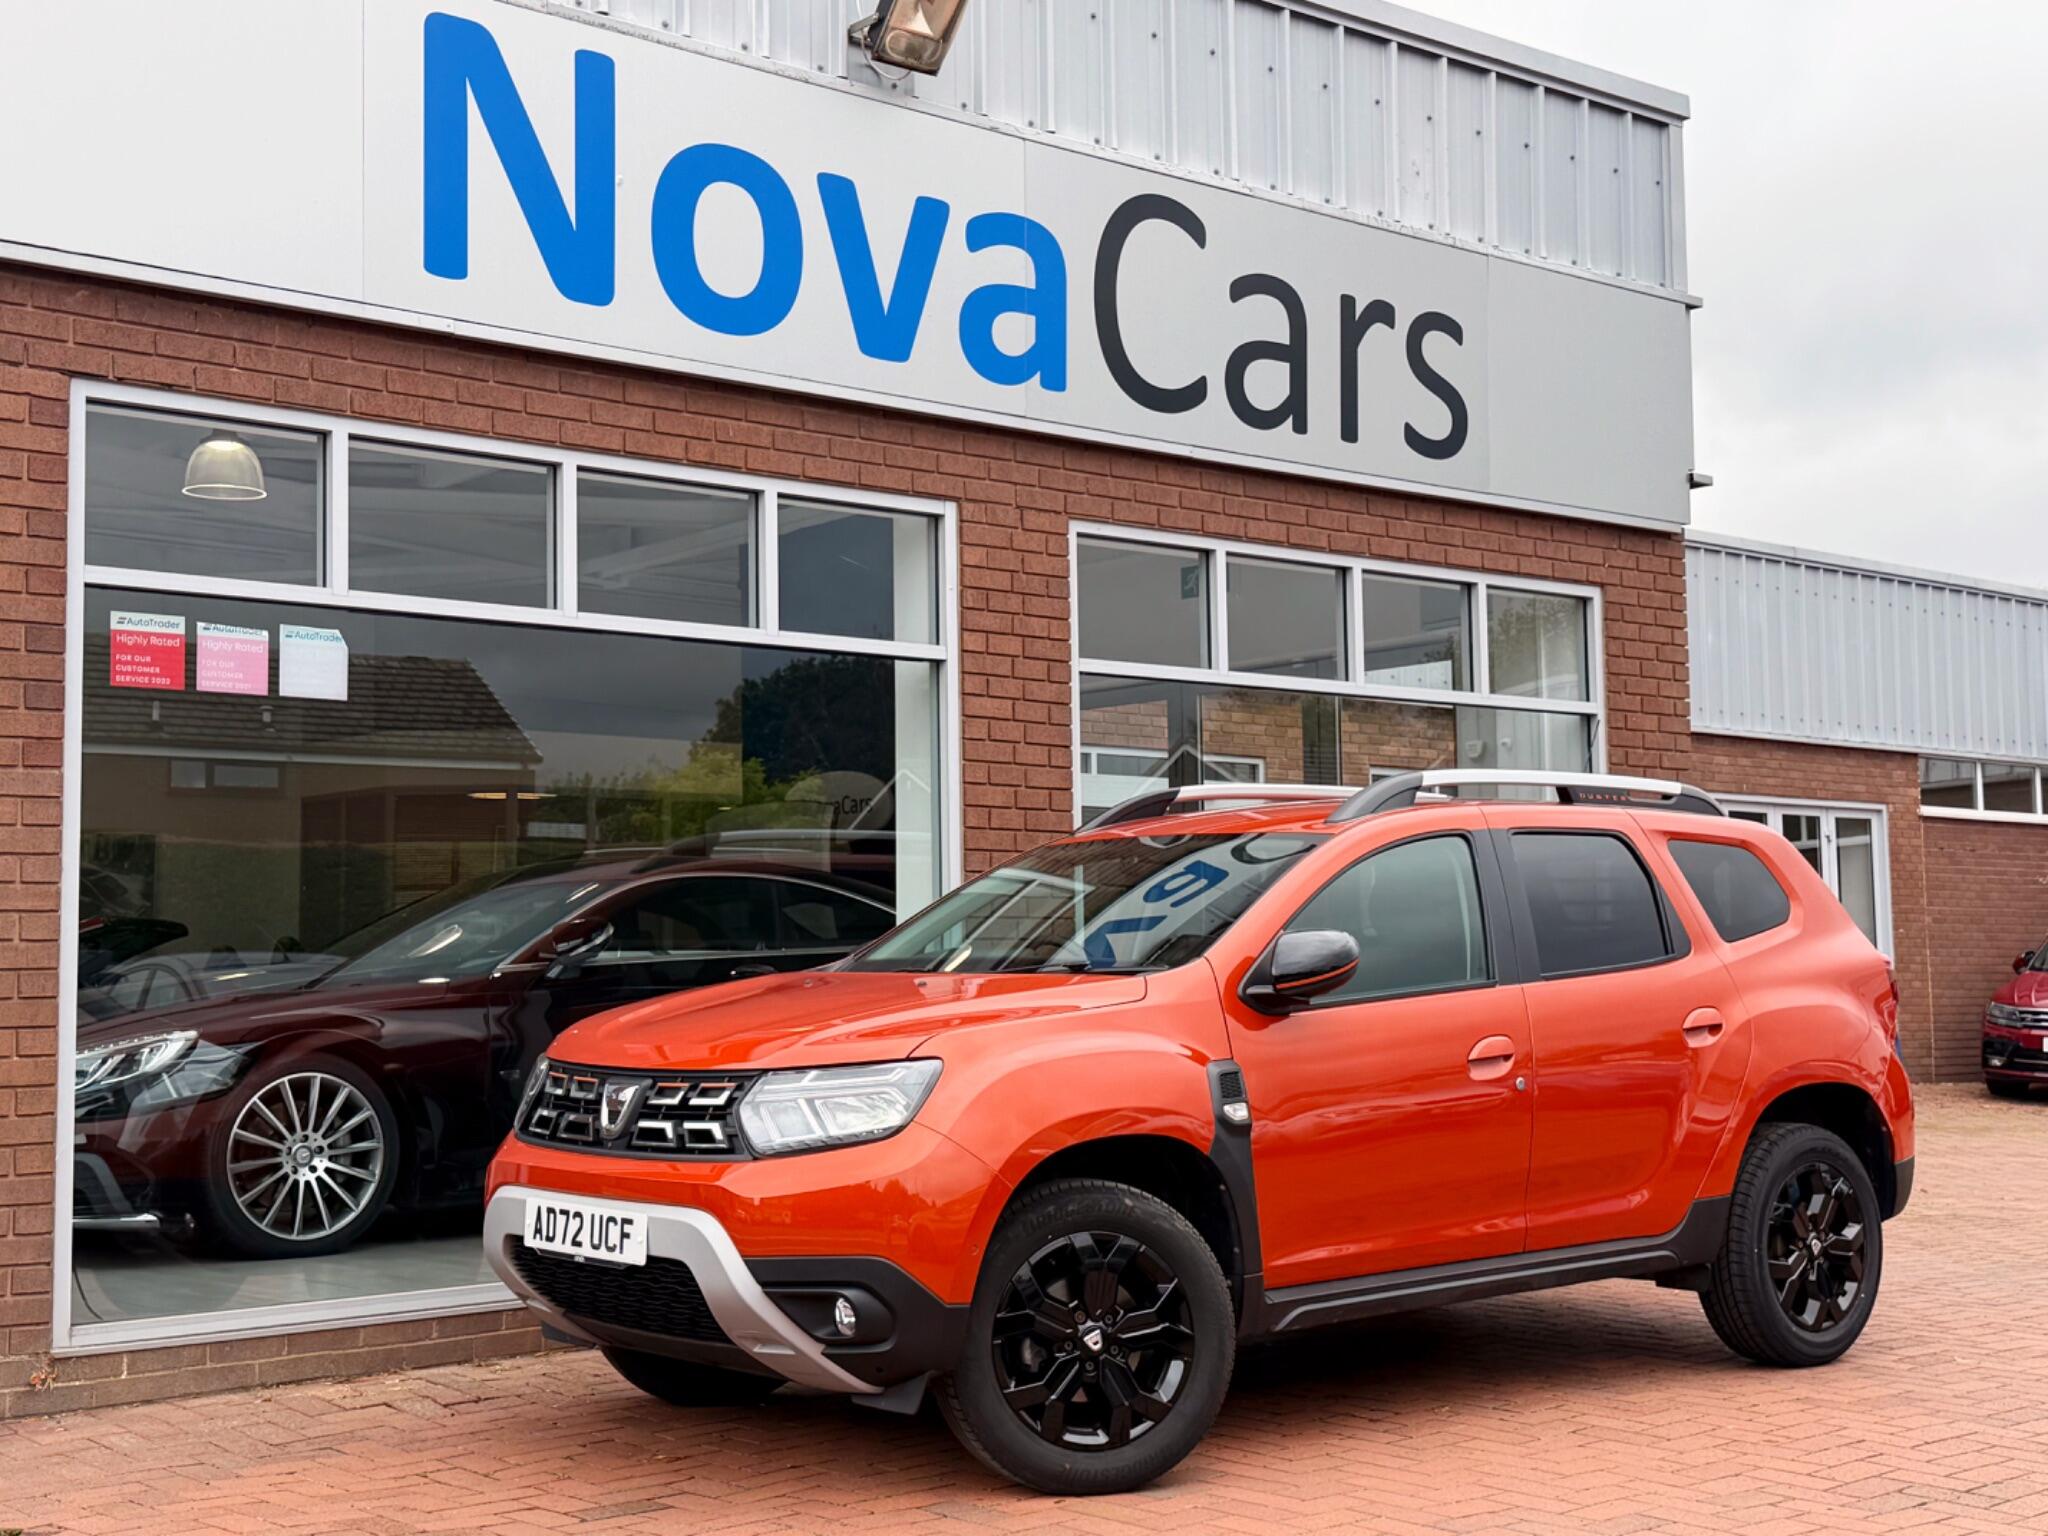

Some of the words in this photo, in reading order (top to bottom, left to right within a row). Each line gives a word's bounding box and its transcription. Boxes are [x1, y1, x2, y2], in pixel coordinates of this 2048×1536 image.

[424, 13, 1468, 461] NovaCars
[126, 617, 181, 630] AutoTrader
[115, 633, 148, 647] Highly
[150, 636, 181, 648] Rated
[202, 640, 233, 653] Highly
[235, 642, 264, 654] Rated
[115, 653, 132, 662] FOR
[134, 654, 152, 663] OUR
[115, 664, 161, 674] CUSTOMER
[1579, 792, 1627, 801] DUSTER
[533, 1205, 585, 1248] AD72
[590, 1213, 635, 1255] UCF
